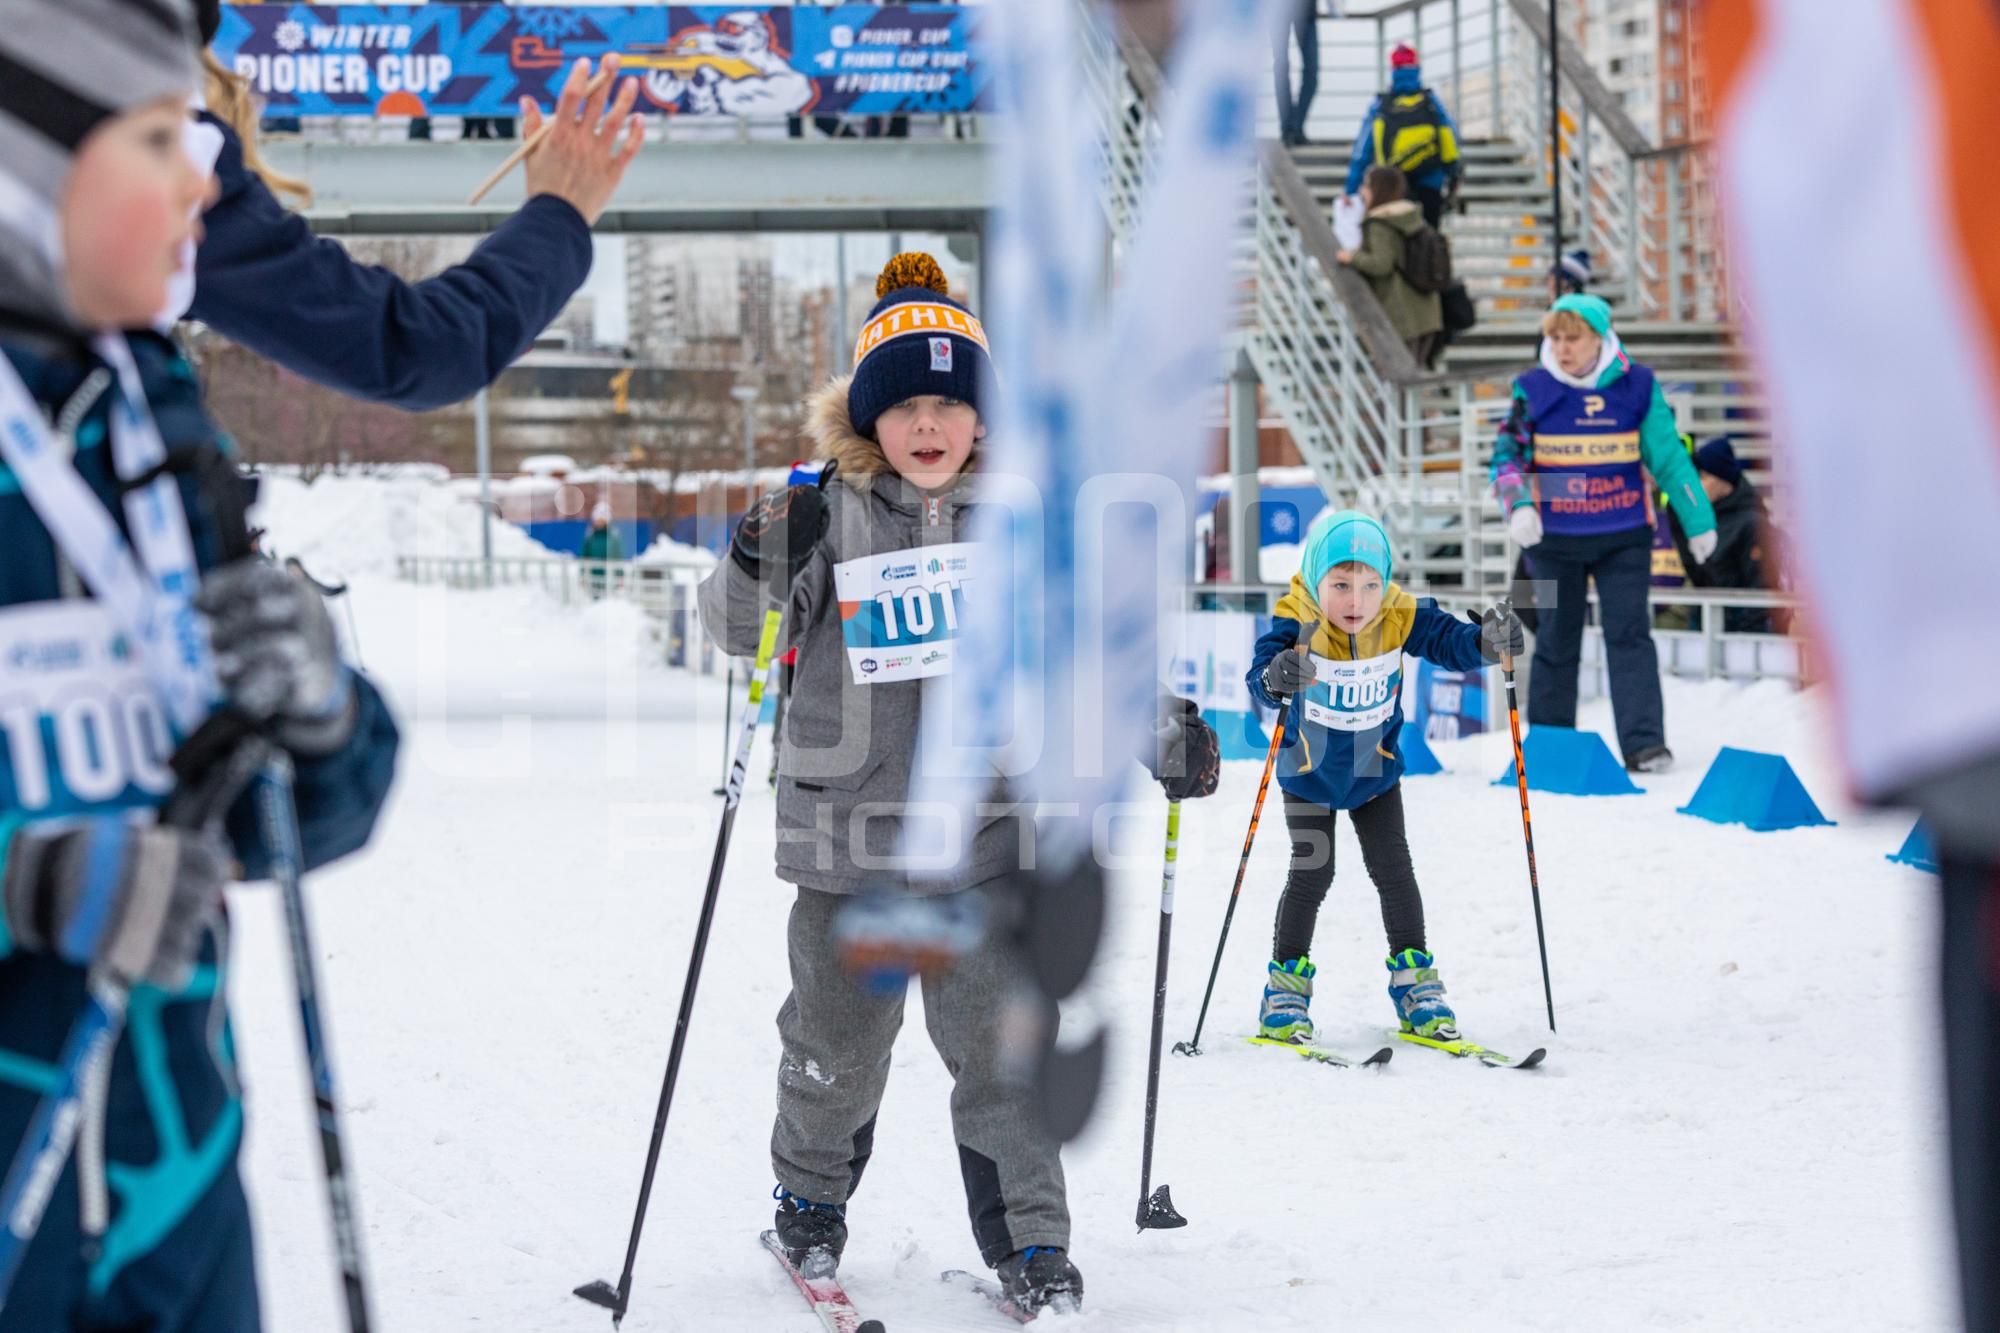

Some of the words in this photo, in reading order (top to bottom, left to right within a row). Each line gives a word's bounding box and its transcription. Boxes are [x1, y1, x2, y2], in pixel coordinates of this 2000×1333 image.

[310, 24, 411, 48] WINTER
[235, 54, 369, 93] PIONER
[376, 54, 451, 93] CUP
[1588, 442, 1618, 457] CUP
[1327, 674, 1389, 709] 1008
